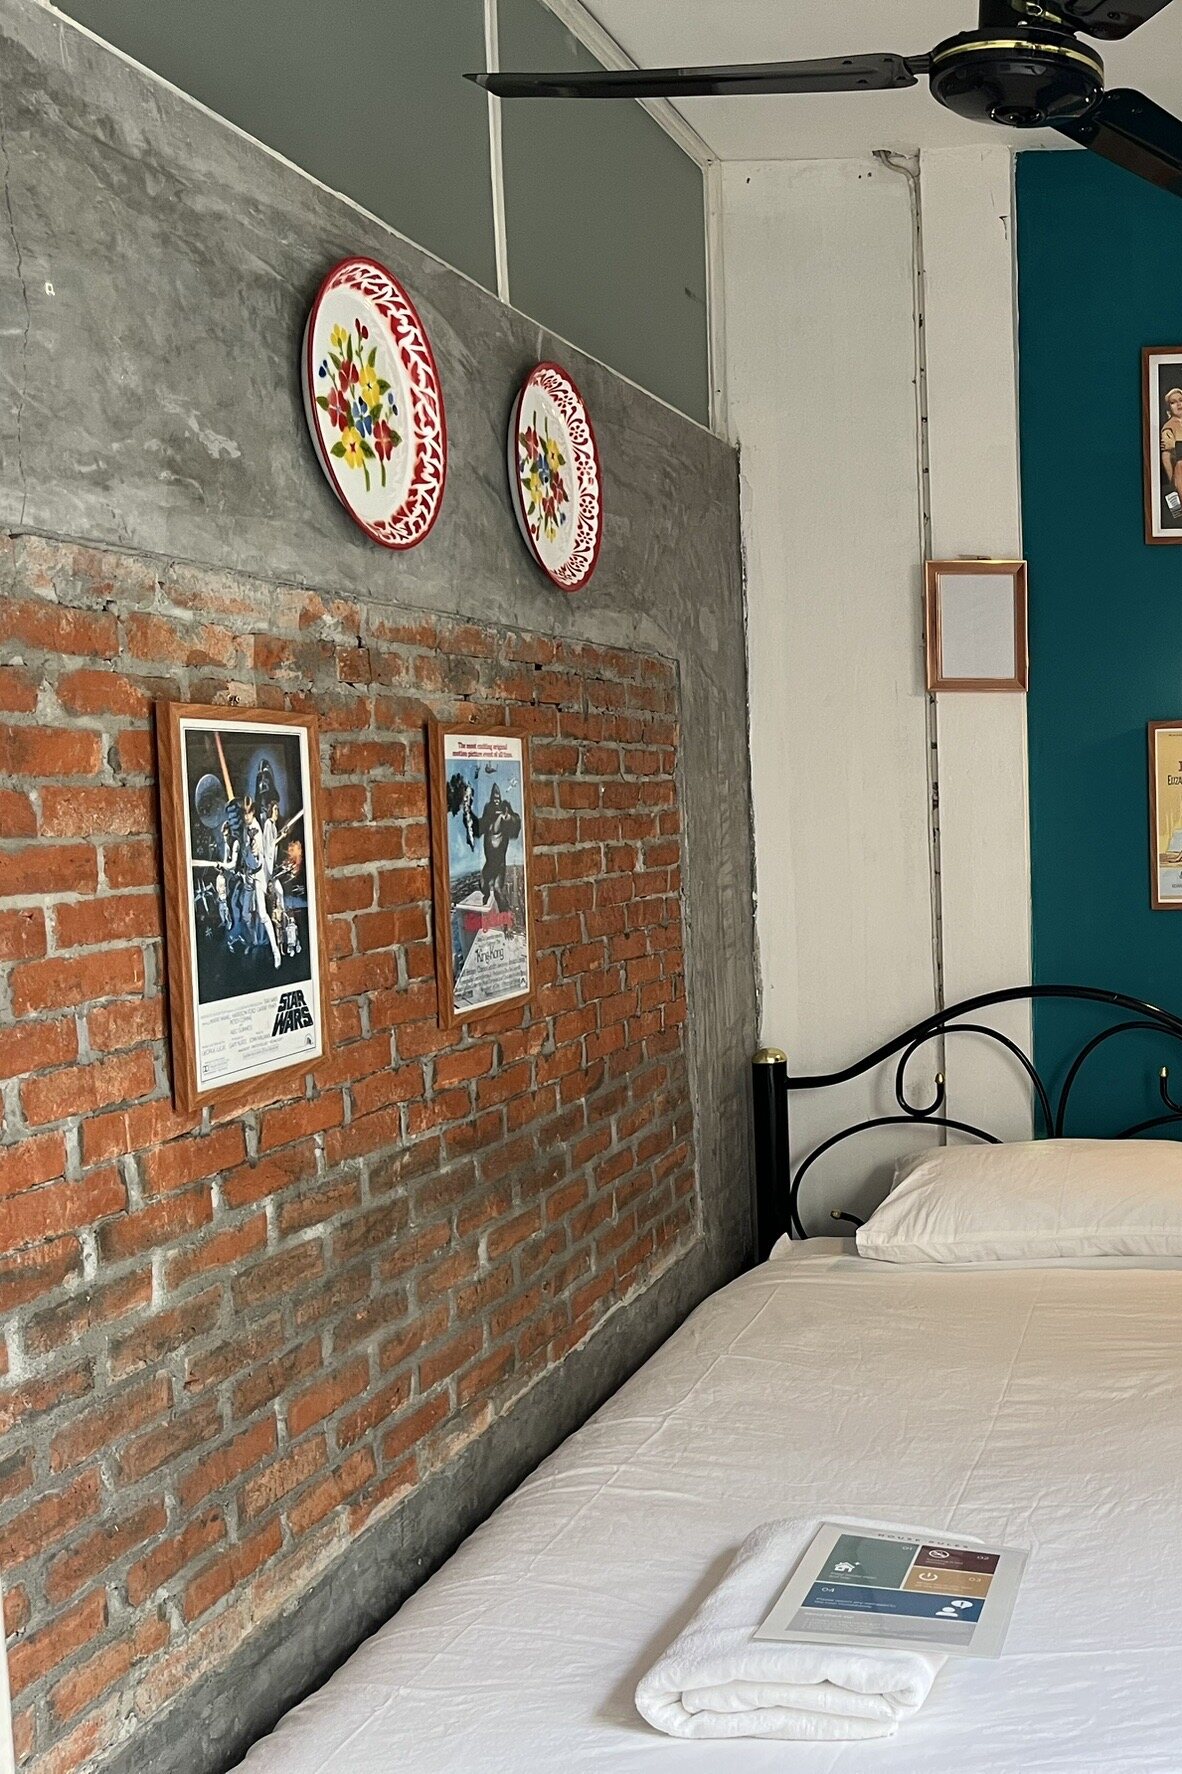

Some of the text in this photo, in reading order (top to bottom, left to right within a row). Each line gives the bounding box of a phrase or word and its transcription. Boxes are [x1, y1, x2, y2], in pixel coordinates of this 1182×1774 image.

[278, 989, 307, 1012] STAR
[272, 1006, 314, 1037] WARS
[878, 1533, 920, 1542] HOUSE
